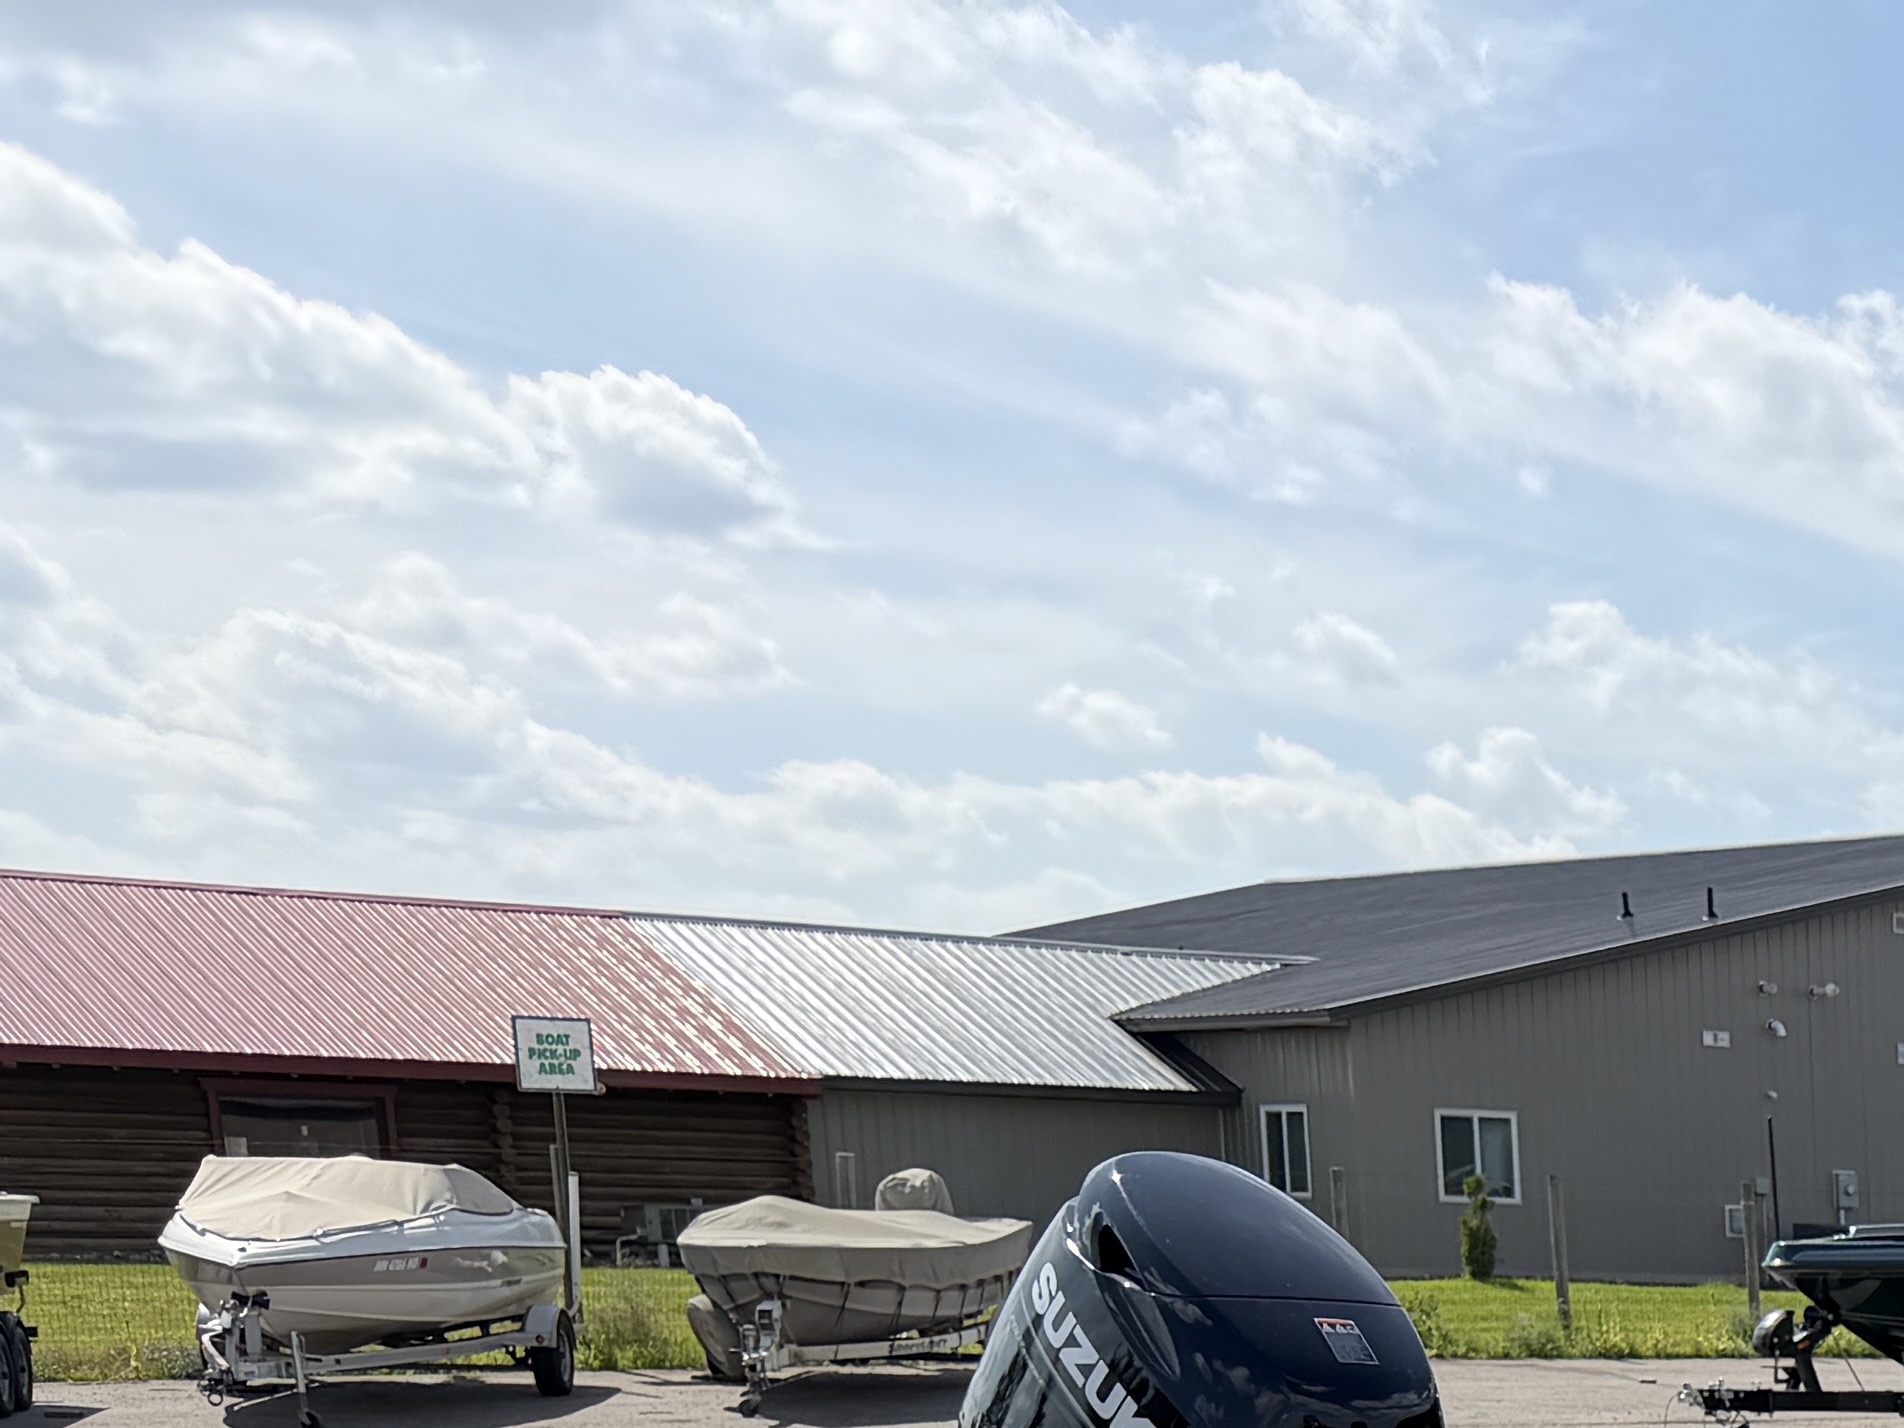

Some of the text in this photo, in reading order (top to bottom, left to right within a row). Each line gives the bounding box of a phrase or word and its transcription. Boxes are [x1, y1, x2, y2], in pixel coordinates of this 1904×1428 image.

[536, 1033, 571, 1046] BOAT
[528, 1047, 581, 1061] PICK-UP
[538, 1062, 576, 1075] AREA
